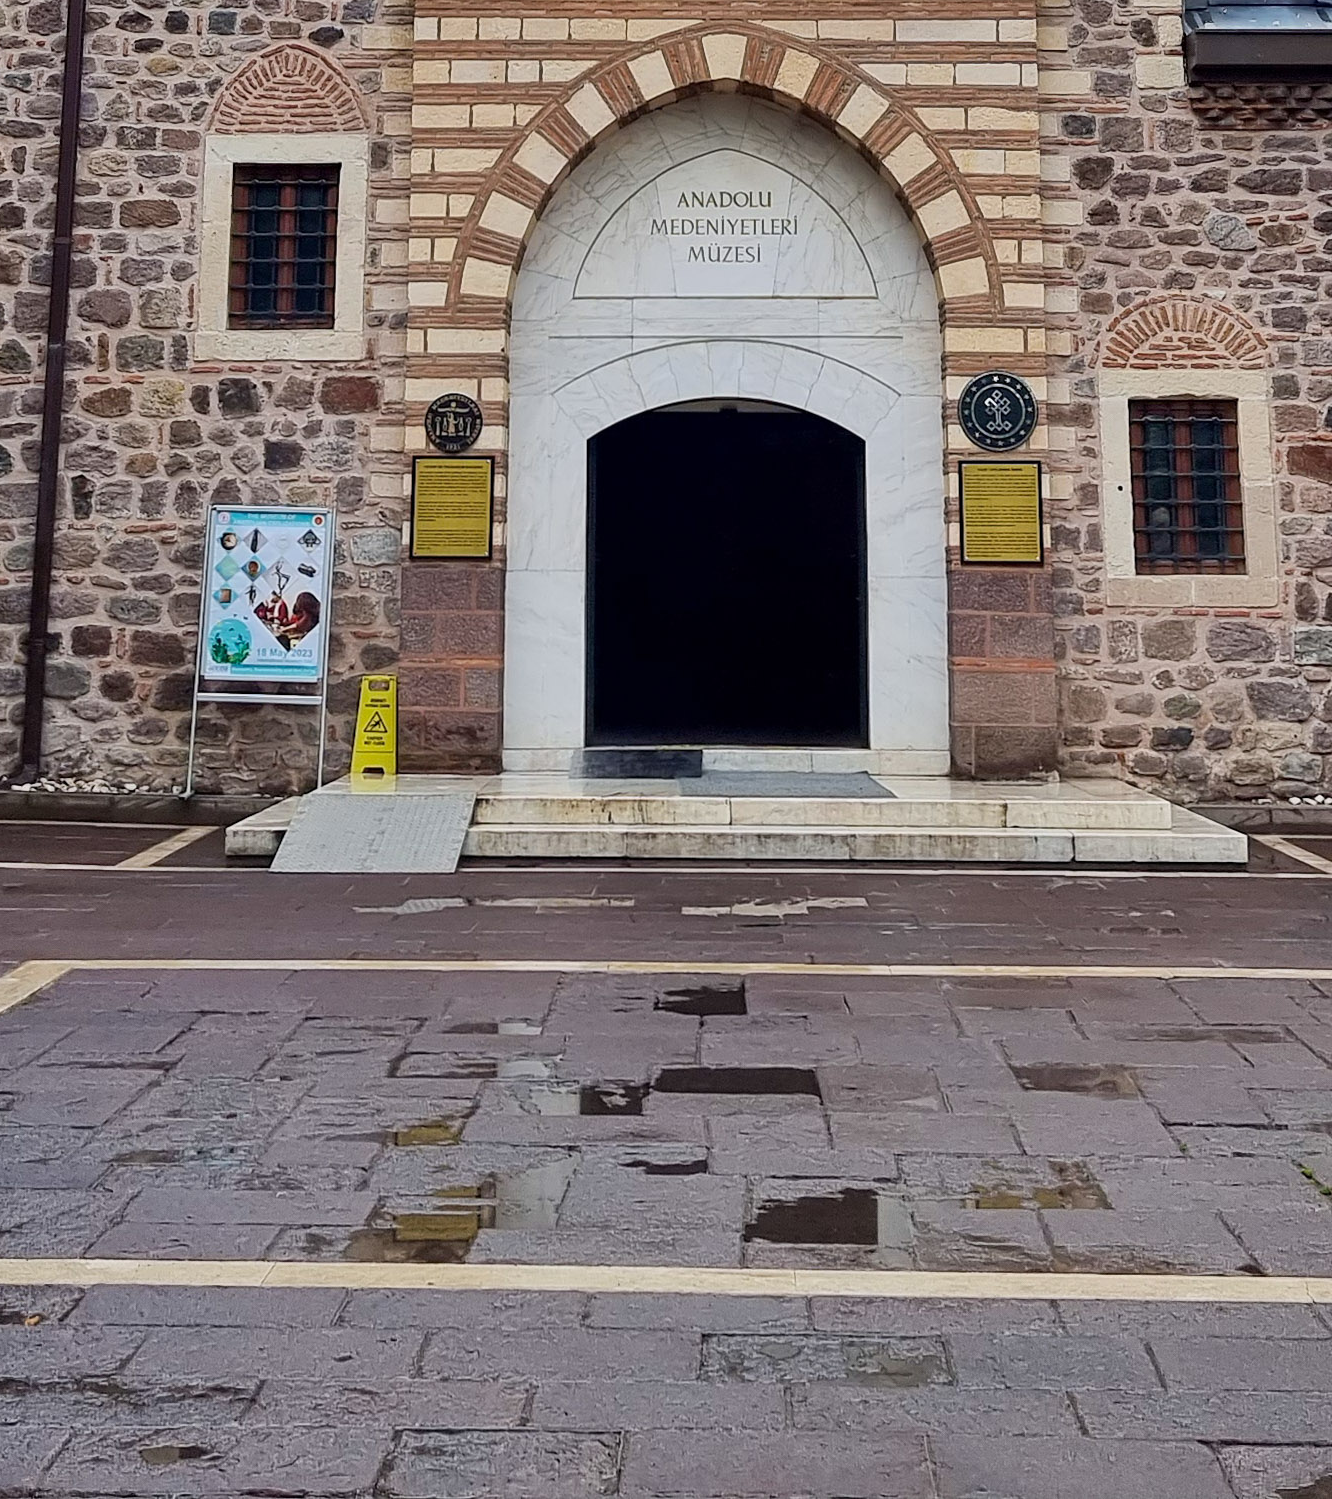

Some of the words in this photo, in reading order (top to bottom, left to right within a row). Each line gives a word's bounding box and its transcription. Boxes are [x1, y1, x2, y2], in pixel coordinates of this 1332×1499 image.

[677, 191, 772, 208] ANADOLU
[650, 215, 798, 236] MEDENİYETLERİ
[687, 243, 761, 263] MÜZESİ
[256, 648, 267, 657] 18
[269, 648, 287, 659] May
[291, 649, 314, 658] 2023
